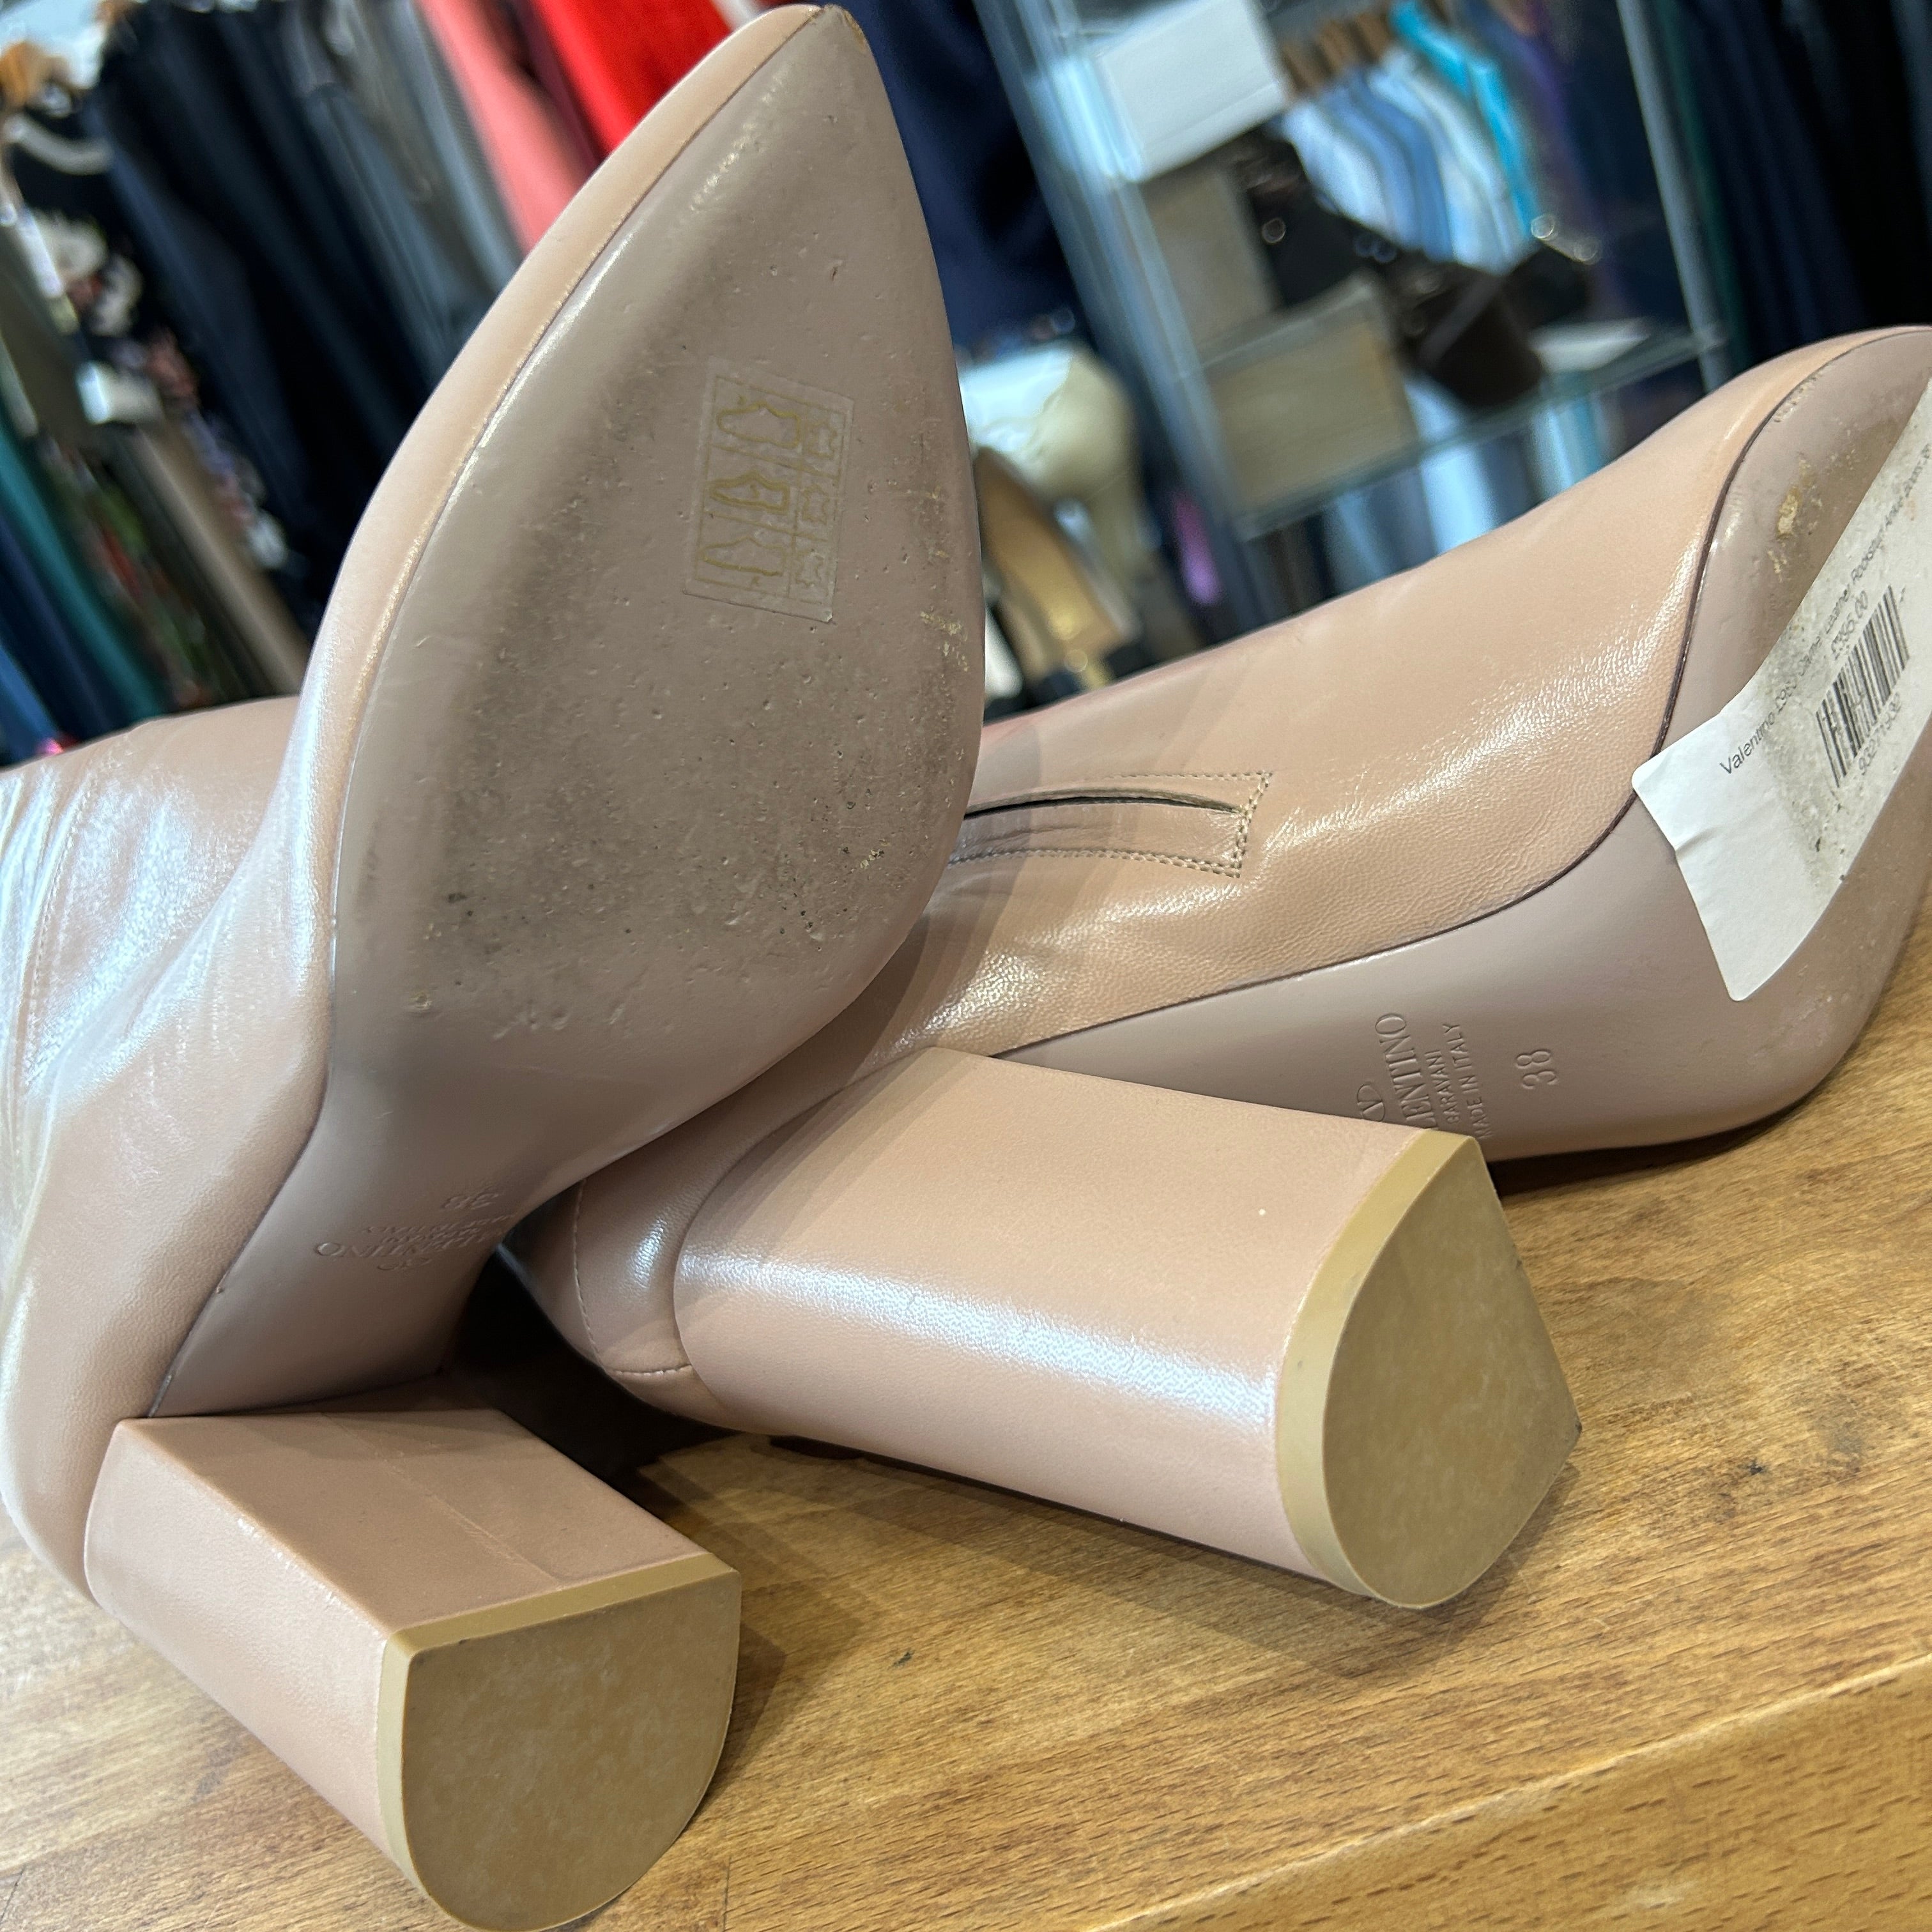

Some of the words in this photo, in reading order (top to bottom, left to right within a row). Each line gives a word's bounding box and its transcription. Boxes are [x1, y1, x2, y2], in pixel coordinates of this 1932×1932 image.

[1719, 711, 1775, 774] Valentino
[1441, 1023, 1473, 1071] ITALY
[1514, 1048, 1558, 1090] 38
[1458, 1074, 1480, 1094] IN
[1466, 1096, 1494, 1140] MADE
